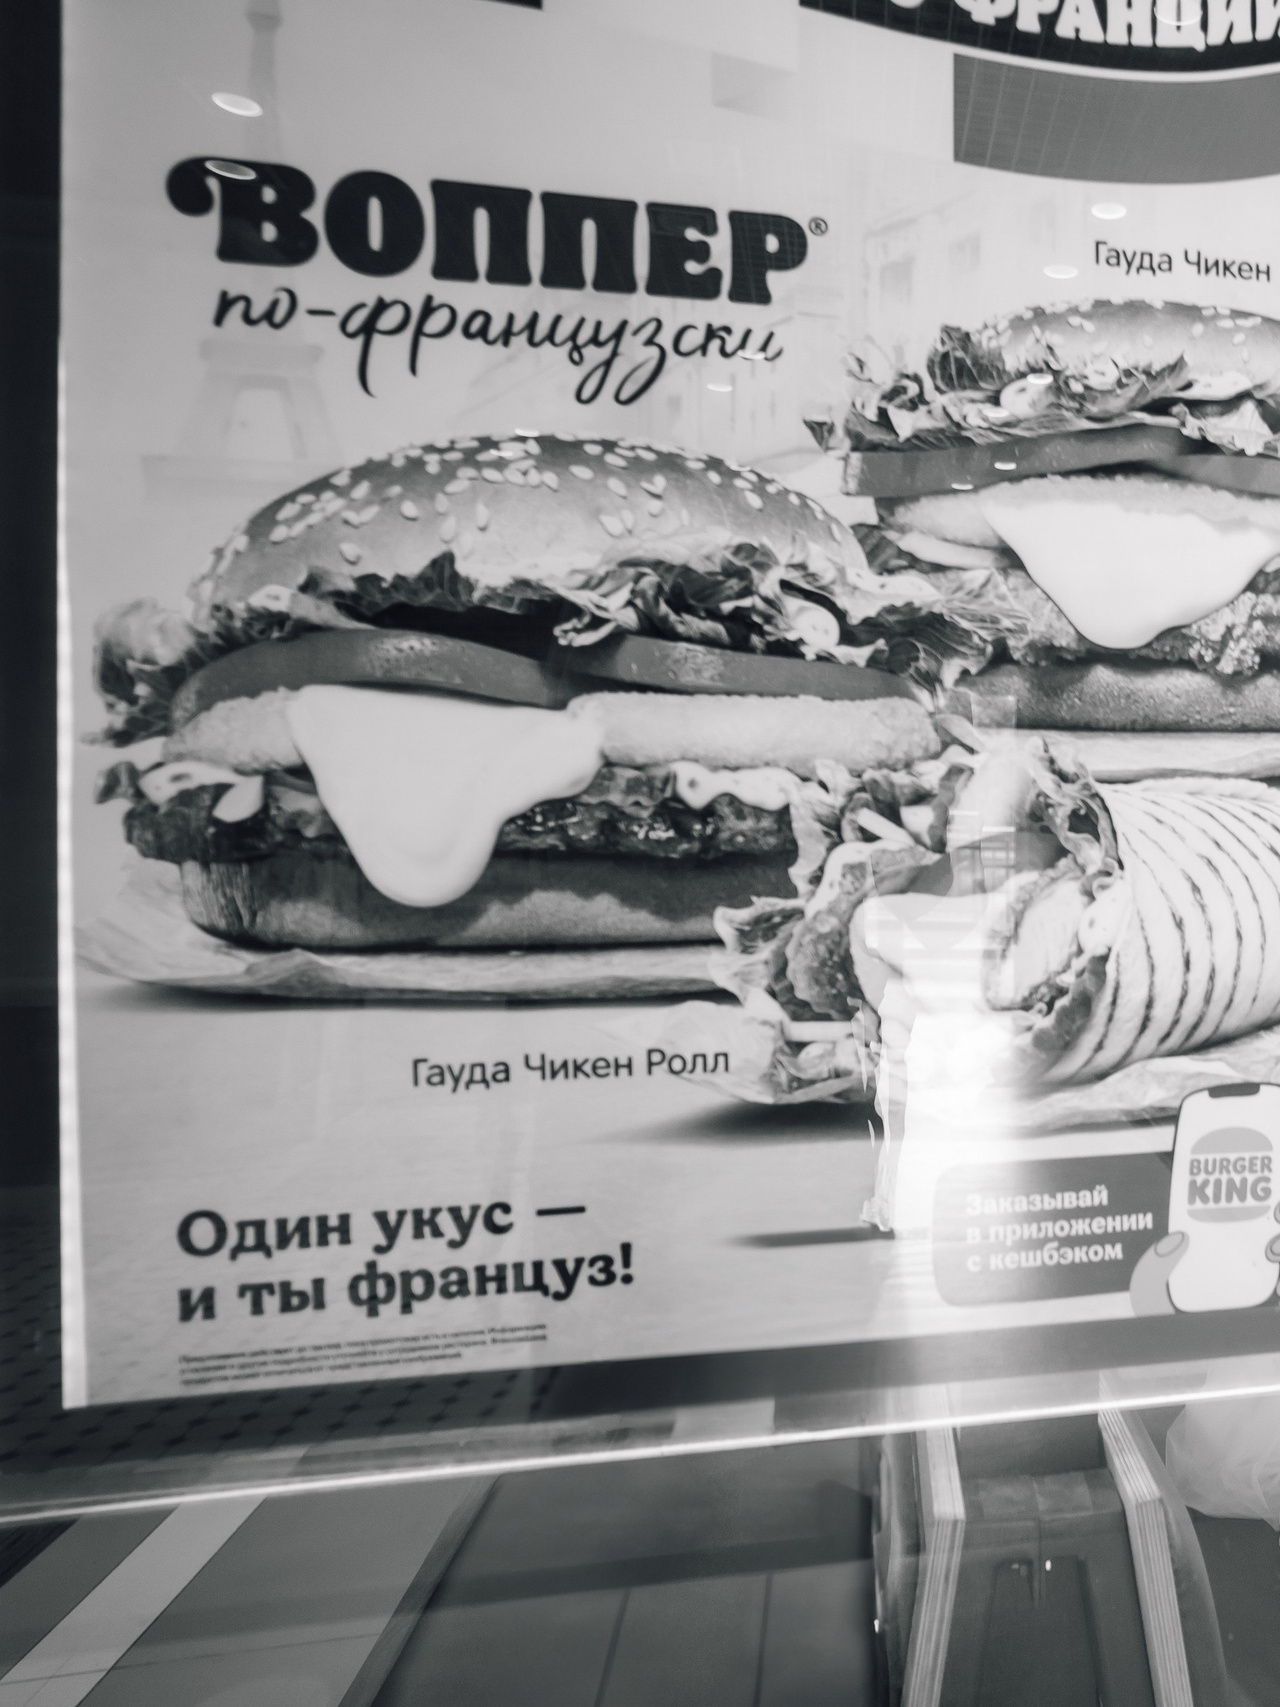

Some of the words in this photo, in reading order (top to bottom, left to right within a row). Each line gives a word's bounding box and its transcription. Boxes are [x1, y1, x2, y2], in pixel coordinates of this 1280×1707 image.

[1094, 240, 1172, 276] Гауда
[1183, 249, 1272, 284] Чикен
[212, 287, 784, 406] по-французски
[411, 1058, 512, 1093] Гауда
[523, 1052, 634, 1083] Чикен
[646, 1048, 731, 1077] Ролл
[1189, 1152, 1273, 1176] BURGER
[966, 1184, 1108, 1215] Заказывай
[1187, 1175, 1273, 1206] KING
[176, 1208, 352, 1262] Один
[373, 1199, 514, 1257] укус
[988, 1211, 1154, 1247] приложении
[966, 1254, 982, 1273] с
[989, 1241, 1123, 1273] кешбэком
[177, 1282, 217, 1323] и
[238, 1275, 326, 1317] ты
[346, 1241, 636, 1319] француз!
